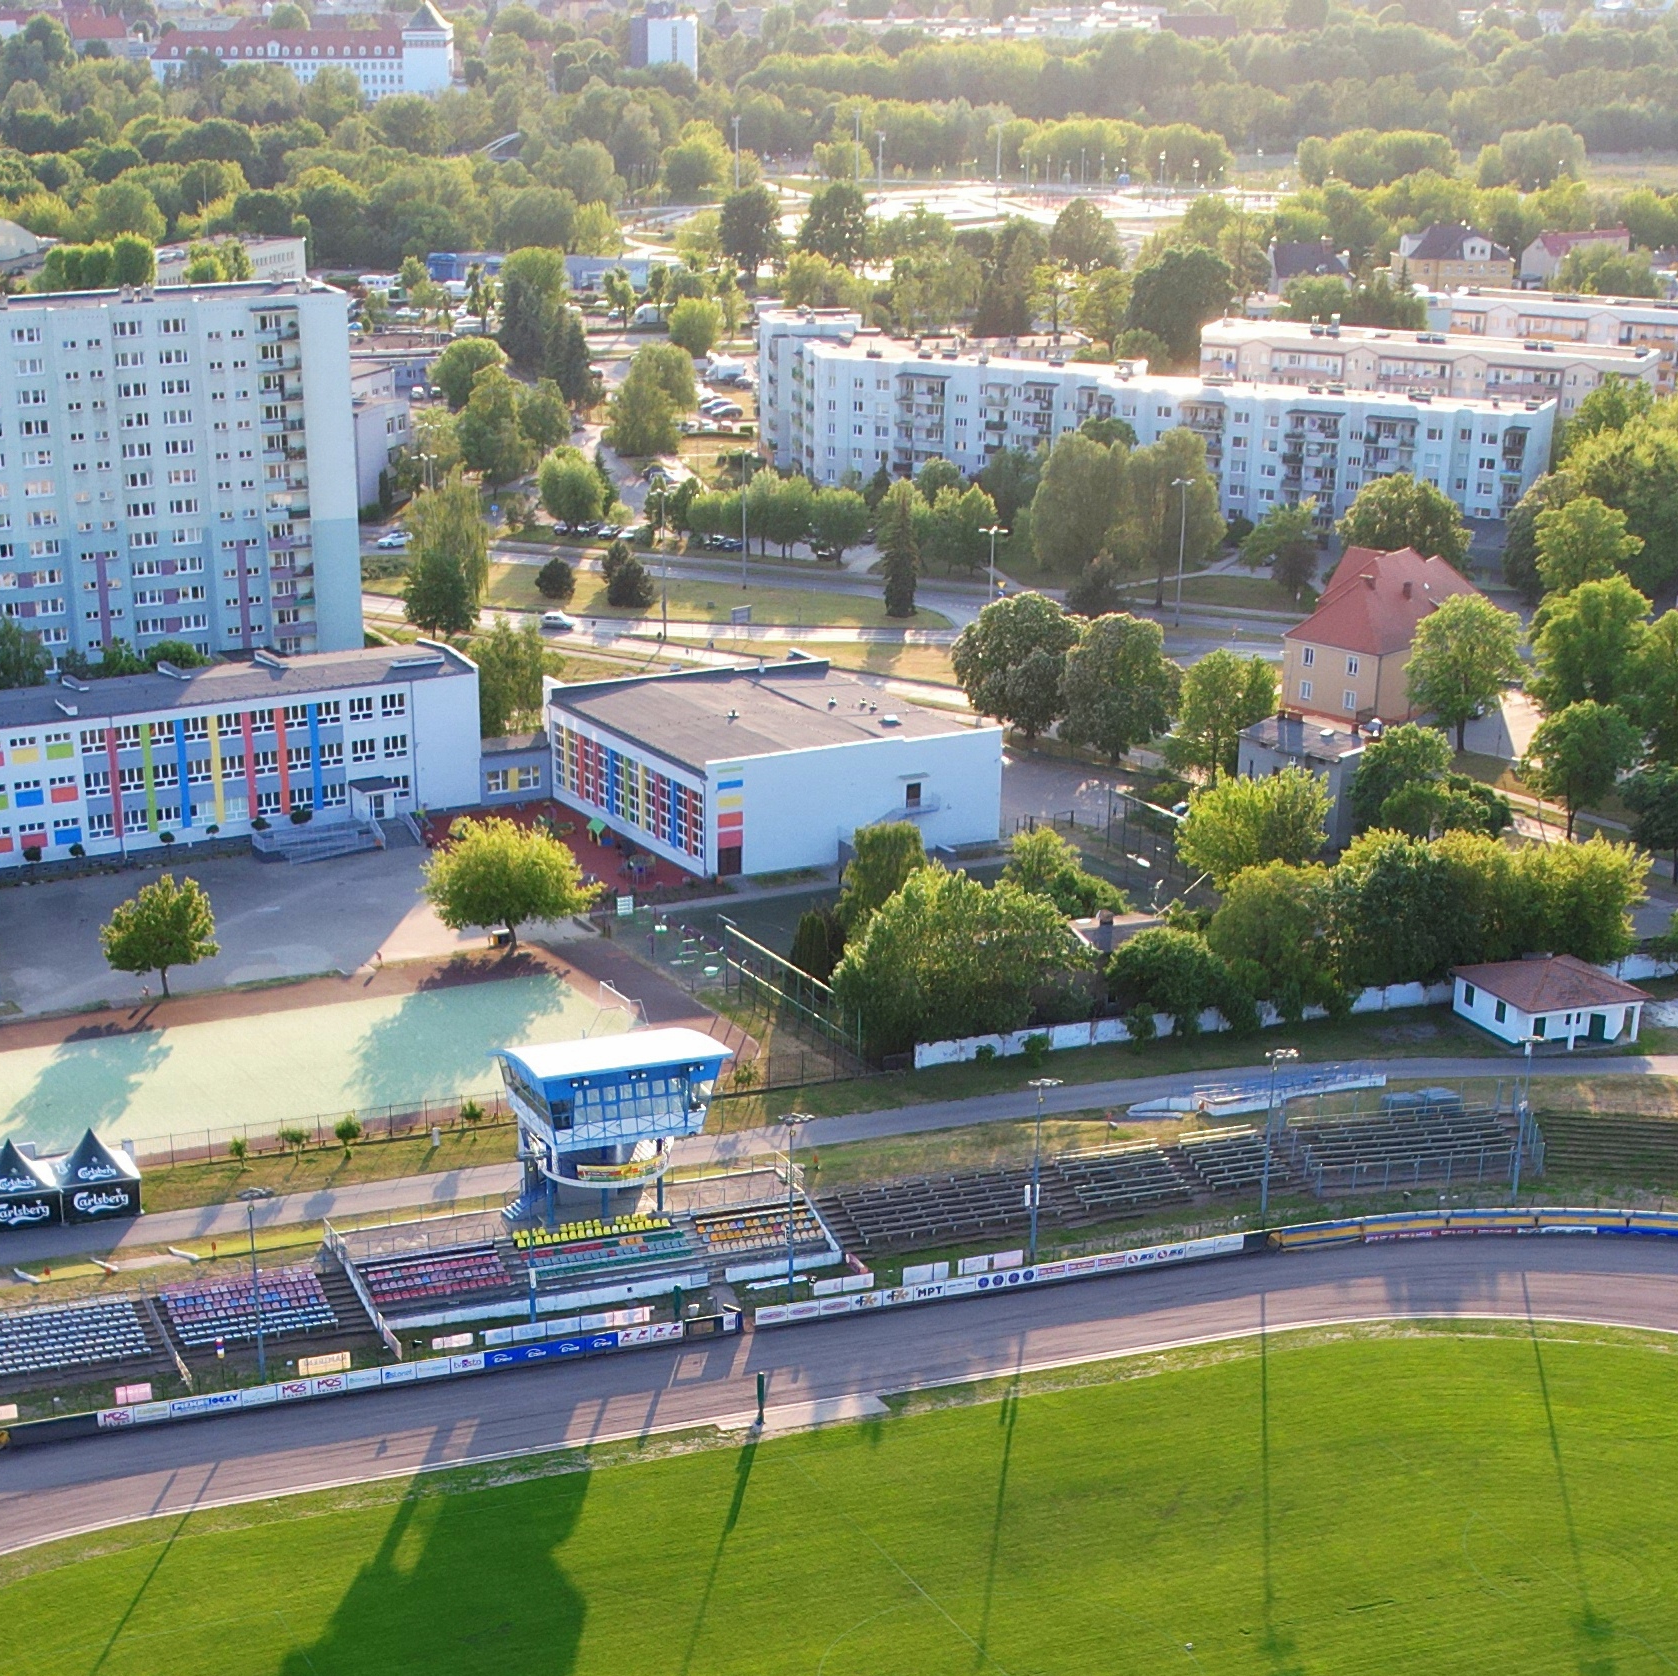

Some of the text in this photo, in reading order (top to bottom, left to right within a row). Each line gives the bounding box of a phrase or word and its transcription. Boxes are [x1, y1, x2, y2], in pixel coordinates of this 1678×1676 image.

[77, 1164, 117, 1180] Carlsberg
[73, 1189, 129, 1214] Carlsberg
[917, 1286, 943, 1297] MPT
